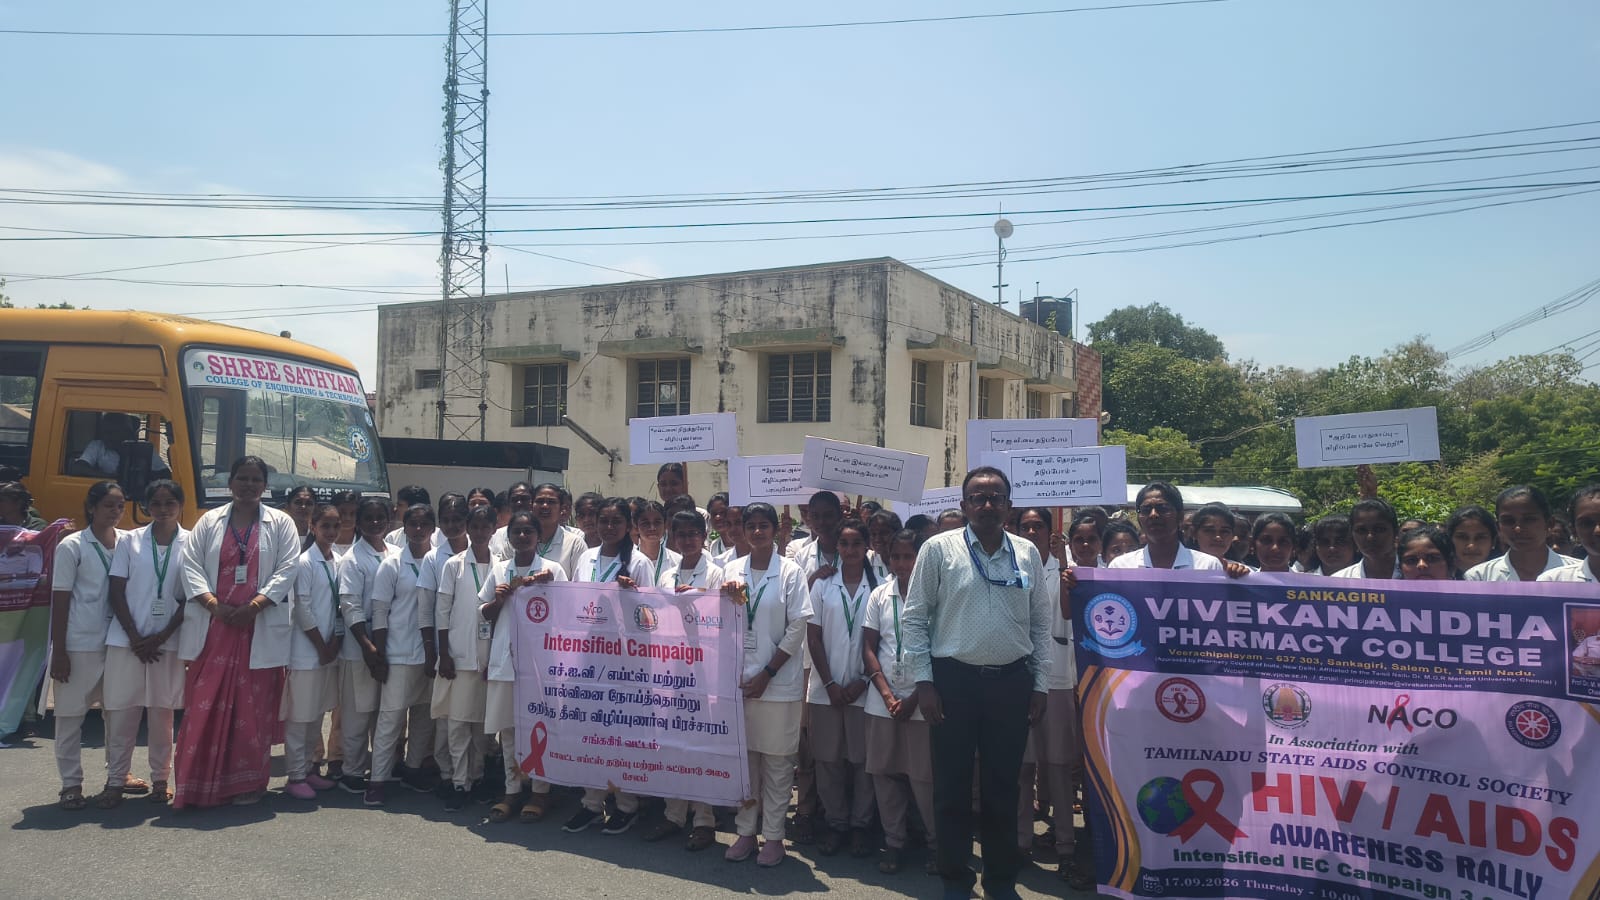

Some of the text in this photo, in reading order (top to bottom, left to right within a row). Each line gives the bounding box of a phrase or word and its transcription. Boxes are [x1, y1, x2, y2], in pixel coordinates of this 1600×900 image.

[205, 375, 249, 387] COLLEGE
[251, 380, 262, 388] OF
[265, 382, 317, 397] ENGINEERING
[207, 354, 359, 395] SHREE SATHYAM
[1286, 589, 1385, 604] SANKAGIRI
[1144, 597, 1558, 641] VIVEKANANDHA
[543, 632, 704, 665] Intensified Campaign
[1158, 626, 1350, 655] PHARMACY
[1361, 637, 1542, 667] COLLEGE
[548, 662, 697, 690] எச்.ஐ.வி / எய்ட்ஸ் மற்றும்
[1168, 648, 1263, 661] Veerachipalayam
[1275, 655, 1296, 663] 637
[1327, 658, 1387, 671] Sankagiri,
[1391, 663, 1430, 673] Salem
[1456, 668, 1492, 676] Tamil
[1496, 669, 1536, 677] Nadu.
[544, 683, 701, 713] பால்வினை நோய்த்தொற்று
[559, 704, 588, 723] தீவிர
[590, 709, 668, 731] விழிப்புணர்வு
[672, 715, 729, 736] பிரச்சாரம்
[1367, 700, 1458, 731] NACO
[1268, 734, 1419, 756] In Association with
[622, 772, 648, 783] சேலம்
[633, 759, 664, 772] மற்றும்
[1144, 747, 1573, 806] TAMILNADU STATE AIDS CONTROL SOCIETY
[1251, 771, 1579, 873] HIV / AIDS
[1173, 848, 1285, 867] Intensified
[1292, 856, 1336, 874] IEC
[1337, 863, 1451, 900] Campaign
[1270, 823, 1543, 900] AWARENESS RALLY
[1164, 877, 1239, 888] 17.09.2026
[1243, 879, 1305, 896] Thursday
